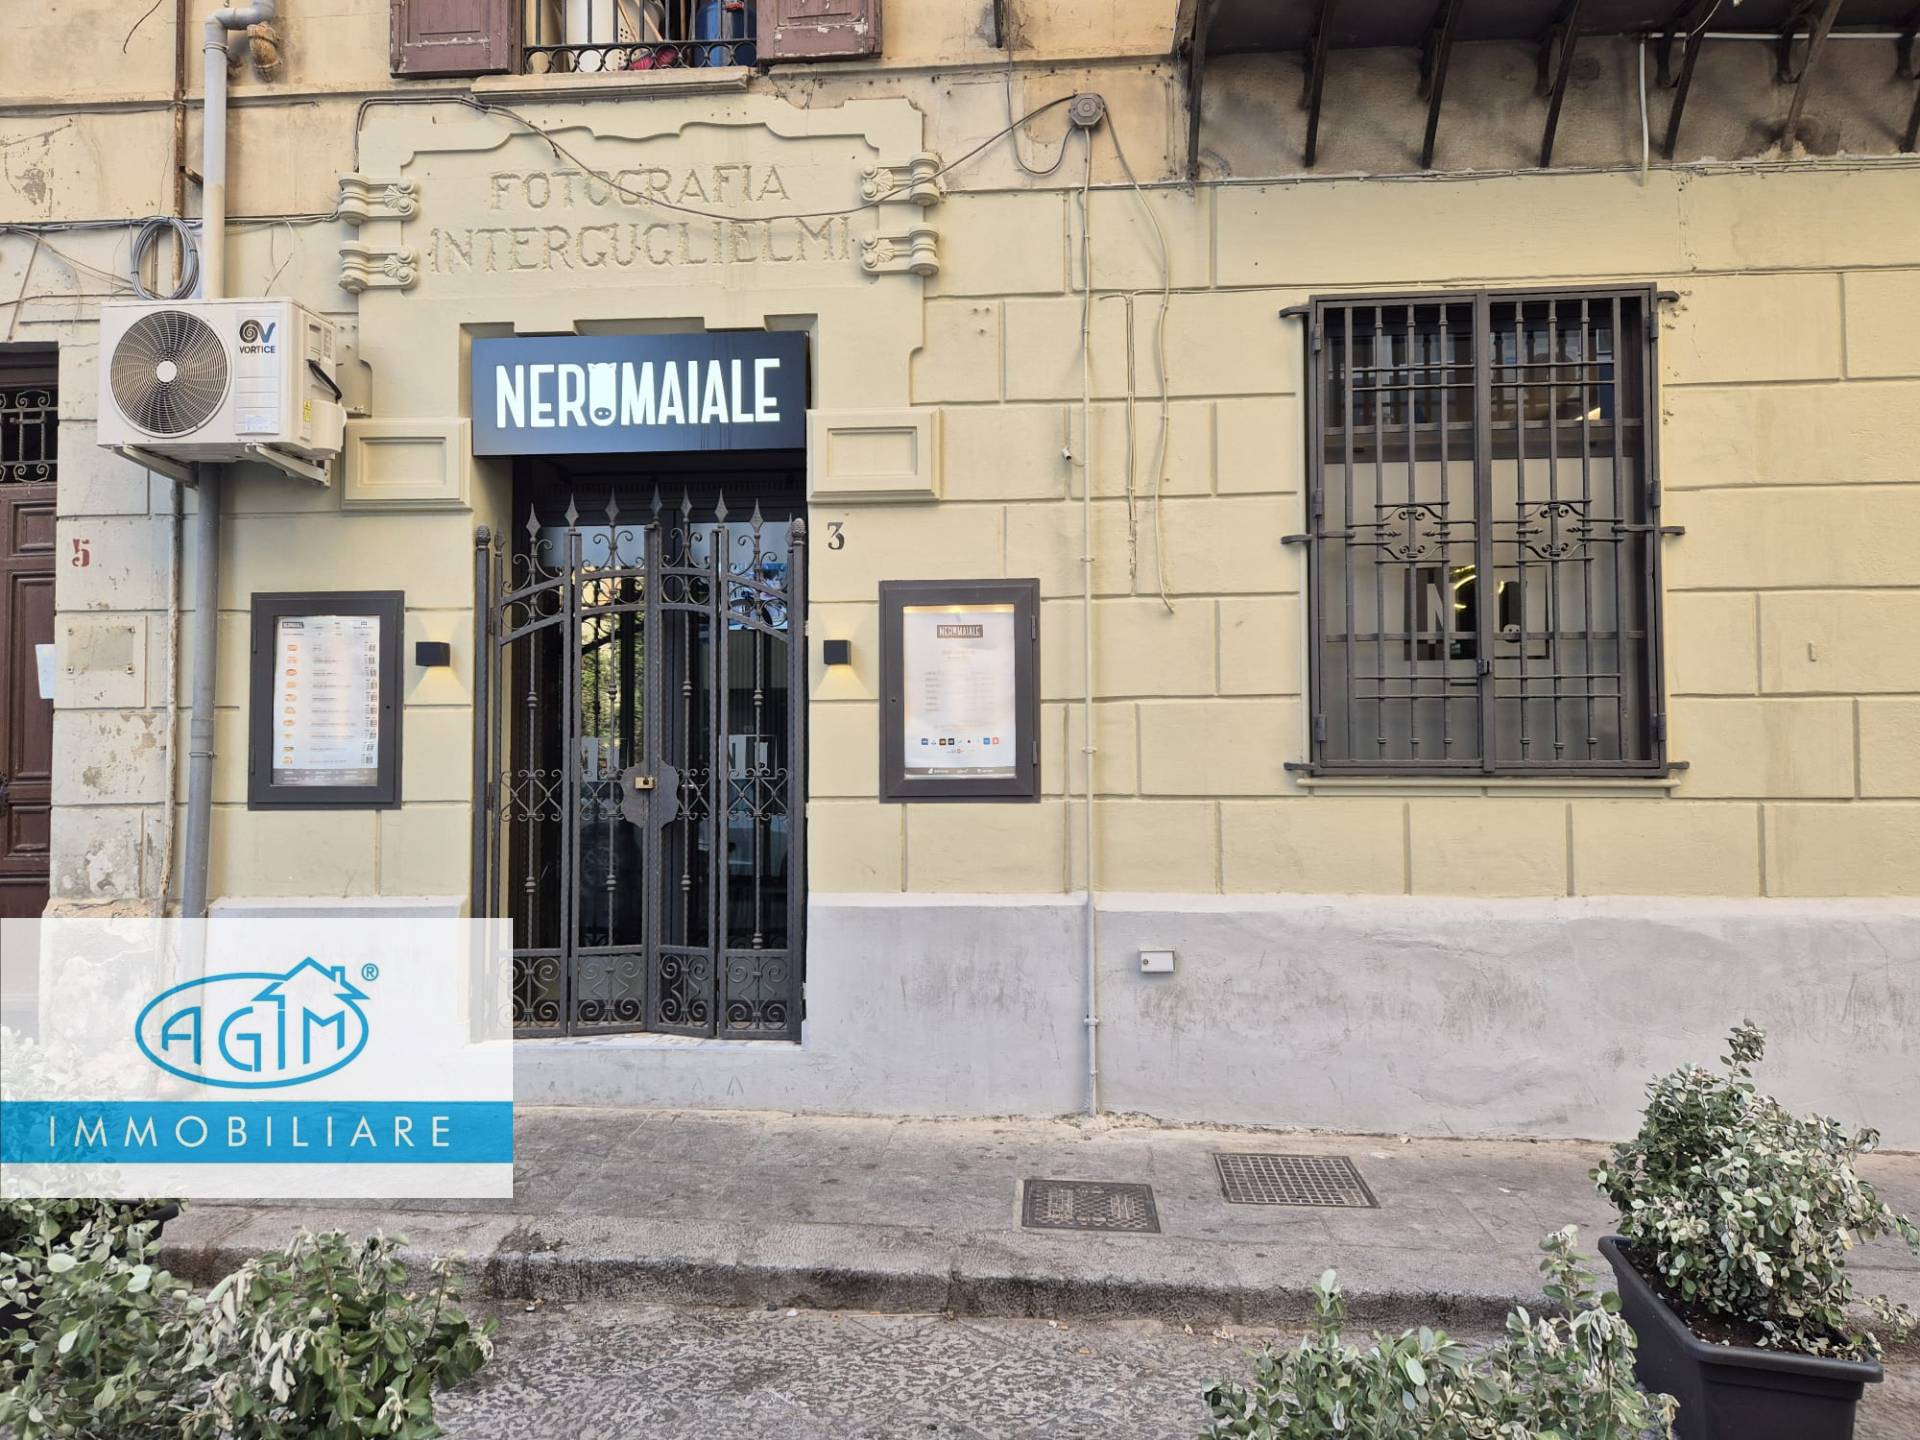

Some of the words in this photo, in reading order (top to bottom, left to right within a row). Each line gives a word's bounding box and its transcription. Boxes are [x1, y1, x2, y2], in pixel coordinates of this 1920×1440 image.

[488, 164, 790, 210] FOTOGRAFIA
[429, 216, 851, 273] INTERGUGLIELMI
[239, 345, 276, 354] VORTICE
[827, 521, 845, 550] 3
[72, 538, 90, 567] 5
